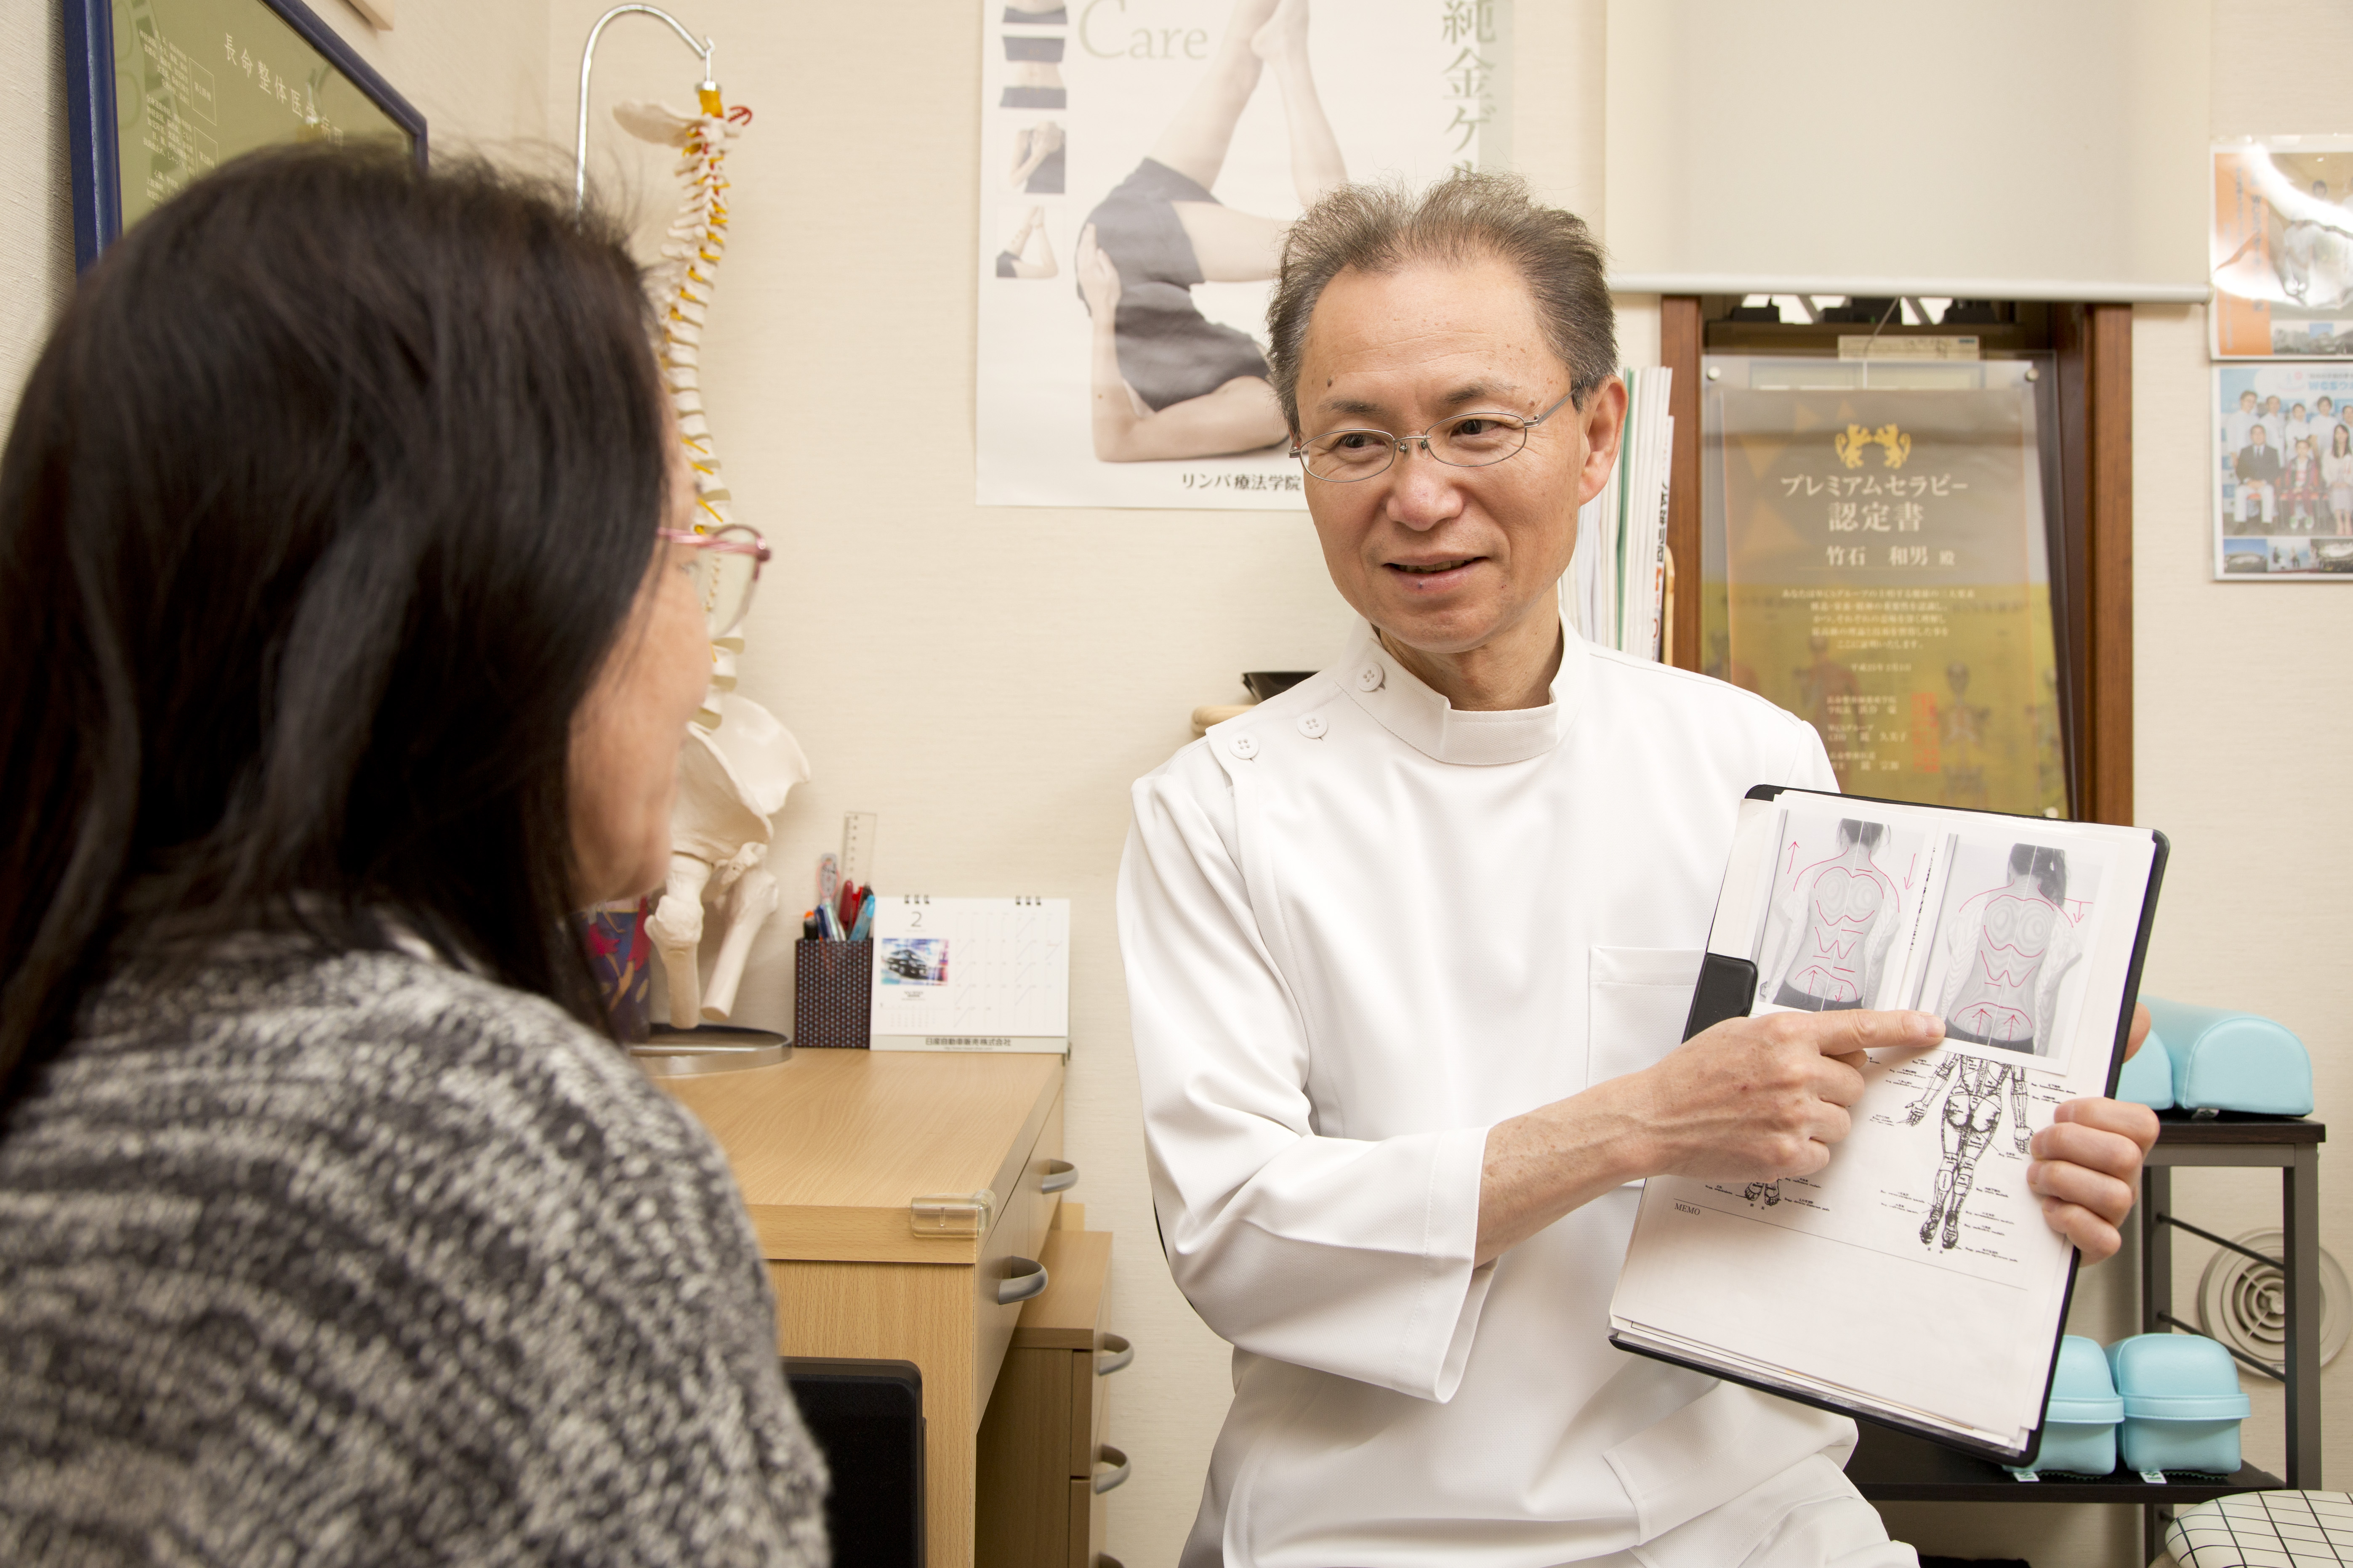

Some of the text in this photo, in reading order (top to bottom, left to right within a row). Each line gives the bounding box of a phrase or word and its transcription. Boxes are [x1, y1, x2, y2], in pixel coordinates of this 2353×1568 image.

[1078, 0, 1208, 60] Care
[1182, 473, 1301, 491] リンパ療法学院
[1781, 473, 1968, 497] プレミアムセラピー
[1827, 501, 1923, 532] 認定書
[1826, 545, 1867, 566] 竹石
[1889, 545, 1928, 566] 和男
[910, 911, 922, 927] 2
[1674, 1203, 1701, 1215] MEMO
